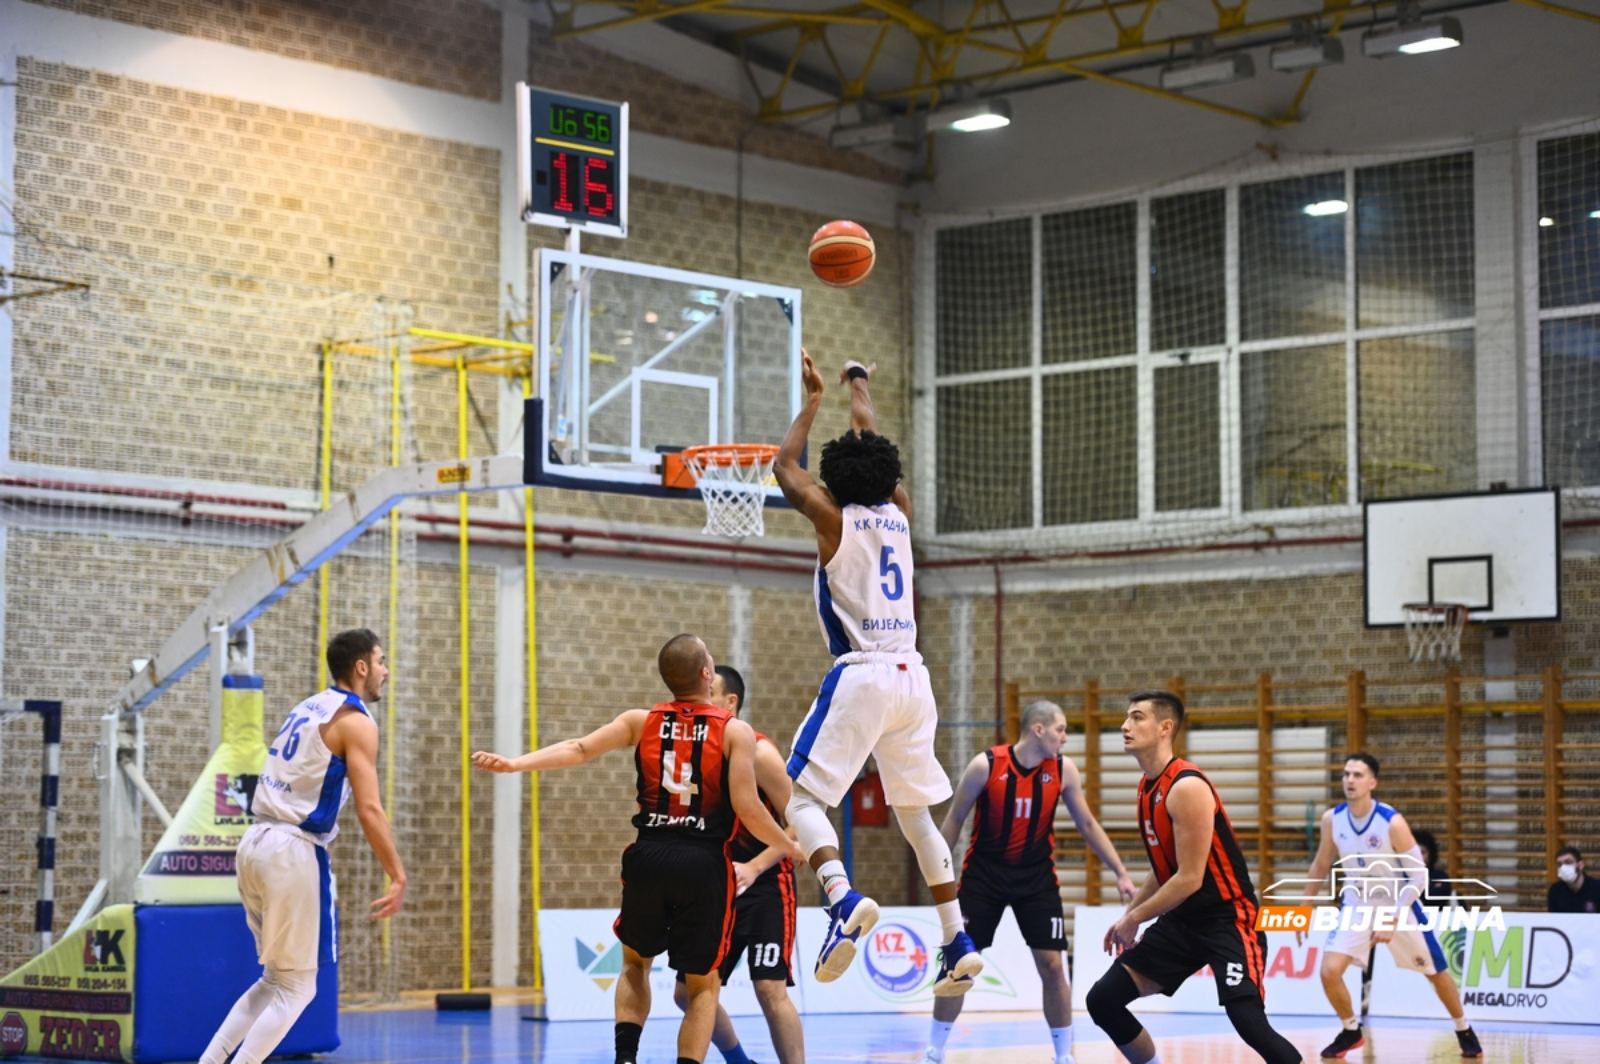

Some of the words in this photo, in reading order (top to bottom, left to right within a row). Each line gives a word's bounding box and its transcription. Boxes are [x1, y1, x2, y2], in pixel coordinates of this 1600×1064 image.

[583, 112, 610, 142] 56
[553, 152, 614, 217] 16
[880, 545, 904, 601] 5
[662, 750, 699, 806] 4
[1016, 798, 1032, 818] 11
[1144, 820, 1160, 846] 5
[160, 855, 198, 872] AUTO
[200, 855, 237, 872] SIGU
[1050, 918, 1064, 939] 11
[754, 943, 780, 967] 10
[875, 933, 906, 953] KZ
[1225, 962, 1244, 986] 5
[1463, 992, 1548, 1008] MEGADRVO
[2, 1027, 23, 1042] STOP
[39, 1015, 121, 1058] ZEDER
